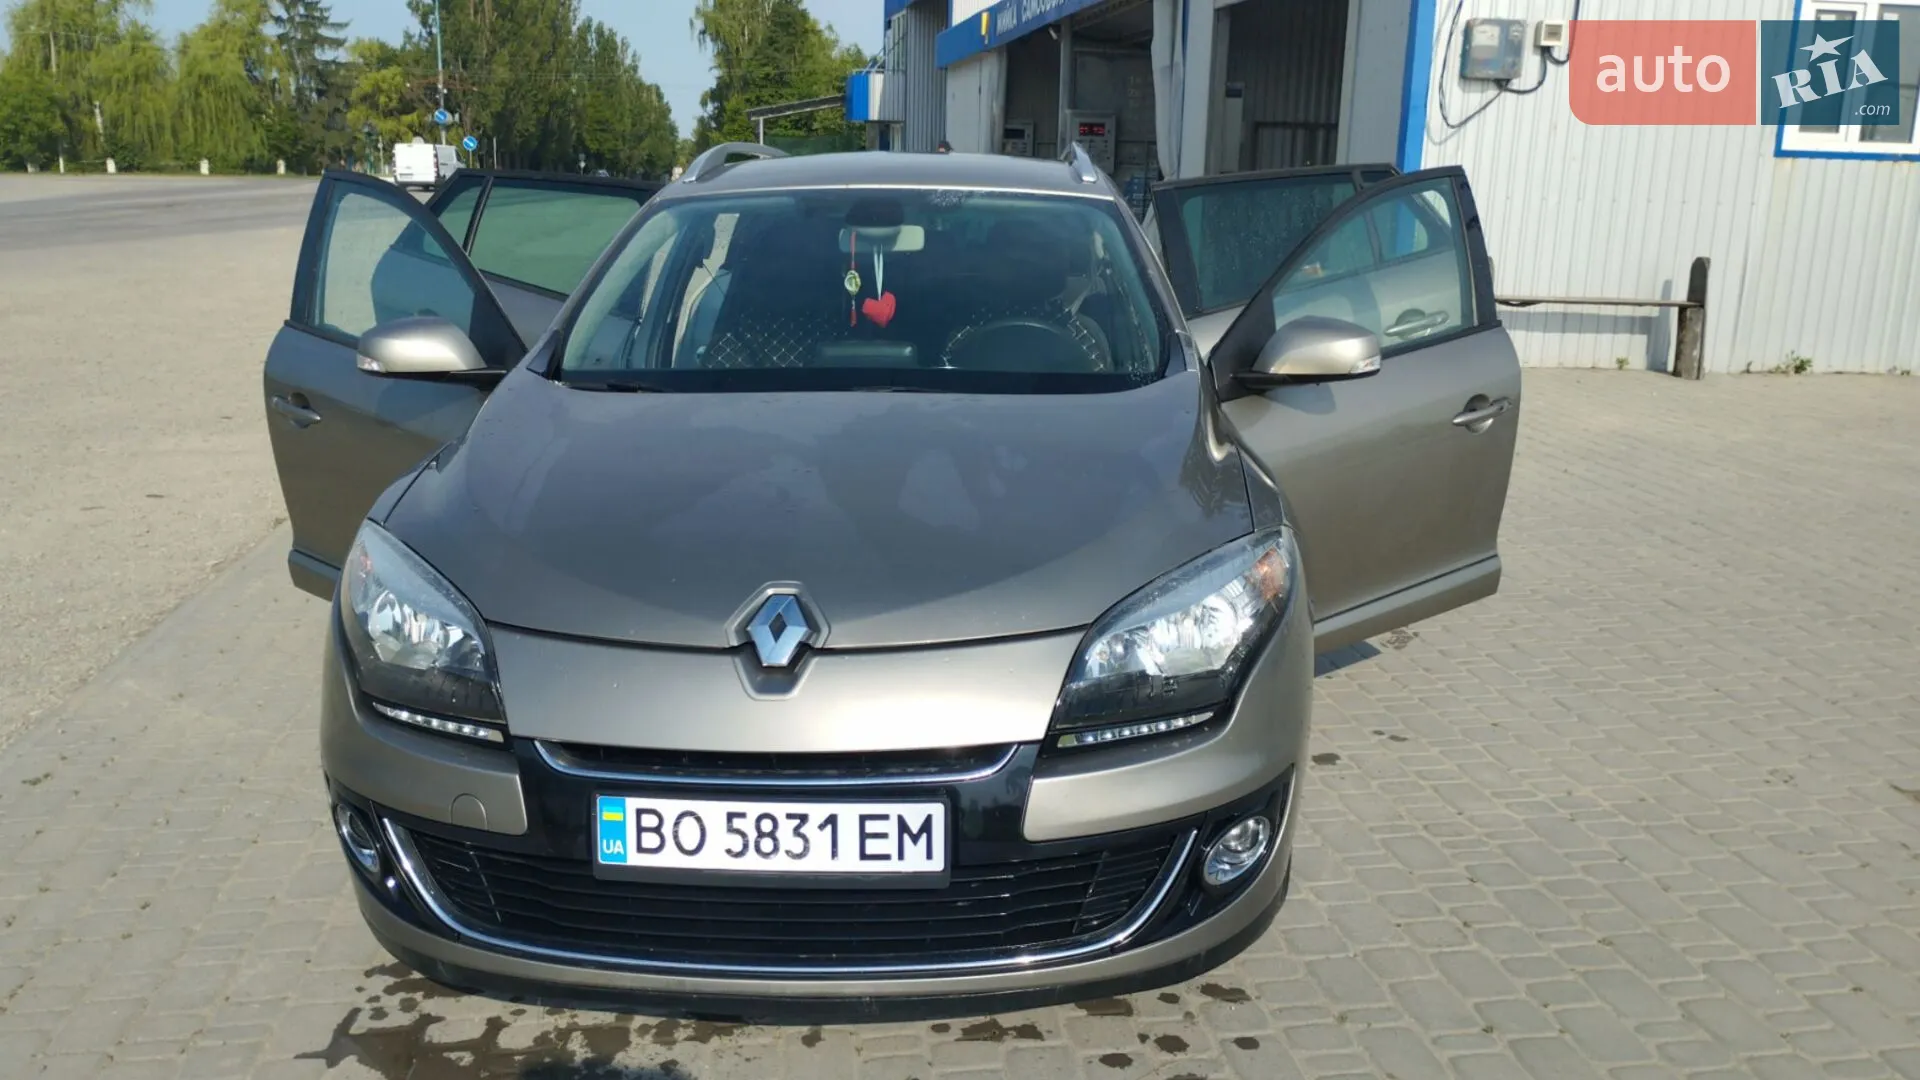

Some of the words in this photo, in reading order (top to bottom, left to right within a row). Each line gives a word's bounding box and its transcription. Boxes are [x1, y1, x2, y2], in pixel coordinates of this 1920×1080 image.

[602, 839, 625, 855] UA
[635, 807, 707, 857] BO
[724, 811, 839, 861] 5831
[859, 813, 934, 862] EM
